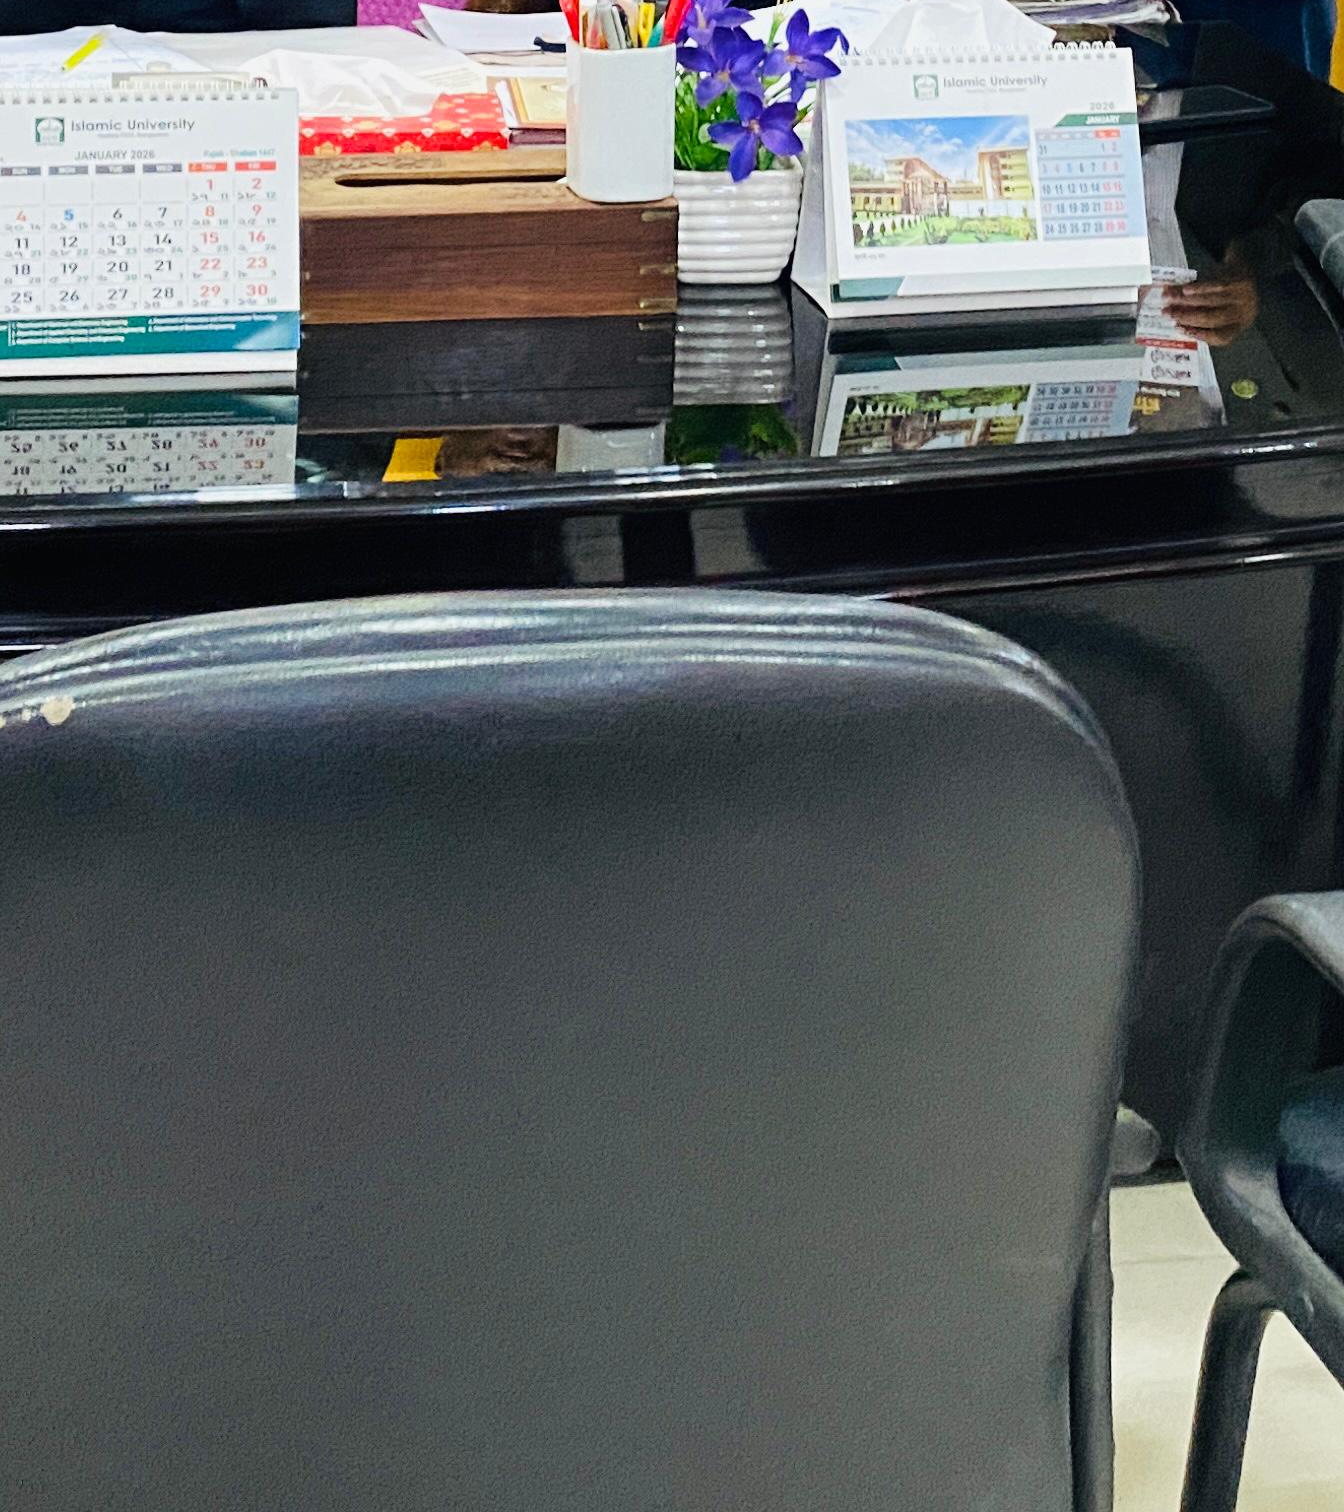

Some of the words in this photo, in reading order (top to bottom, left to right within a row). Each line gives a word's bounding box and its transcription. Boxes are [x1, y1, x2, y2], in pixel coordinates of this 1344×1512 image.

[944, 76, 986, 88] Islamic
[990, 75, 1048, 87] University
[1089, 102, 1115, 110] 2026
[71, 119, 122, 131] Islamic
[127, 118, 196, 132] University
[75, 150, 128, 160] JANUARY
[130, 149, 155, 159] 2026
[207, 179, 213, 190] 1
[252, 178, 262, 190] 2
[16, 210, 27, 222] 4
[64, 209, 74, 221] 5
[113, 208, 122, 220] 6
[158, 207, 167, 218] 7
[205, 206, 215, 217] 8
[252, 204, 262, 216] 9
[15, 238, 29, 249] 11
[61, 236, 78, 247] 12
[109, 235, 126, 246] 13
[154, 233, 172, 245] 14
[200, 232, 219, 244] 15
[249, 231, 266, 243] 16
[14, 264, 30, 275] 18
[61, 263, 78, 274] 19
[107, 261, 128, 272] 20
[155, 260, 172, 271] 21
[200, 258, 221, 270] 22
[246, 257, 267, 268] 23
[11, 291, 32, 303] 25
[59, 290, 79, 302] 26
[108, 289, 128, 300] 27
[153, 288, 174, 299] 28
[200, 285, 221, 297] 29
[246, 284, 268, 296] 30
